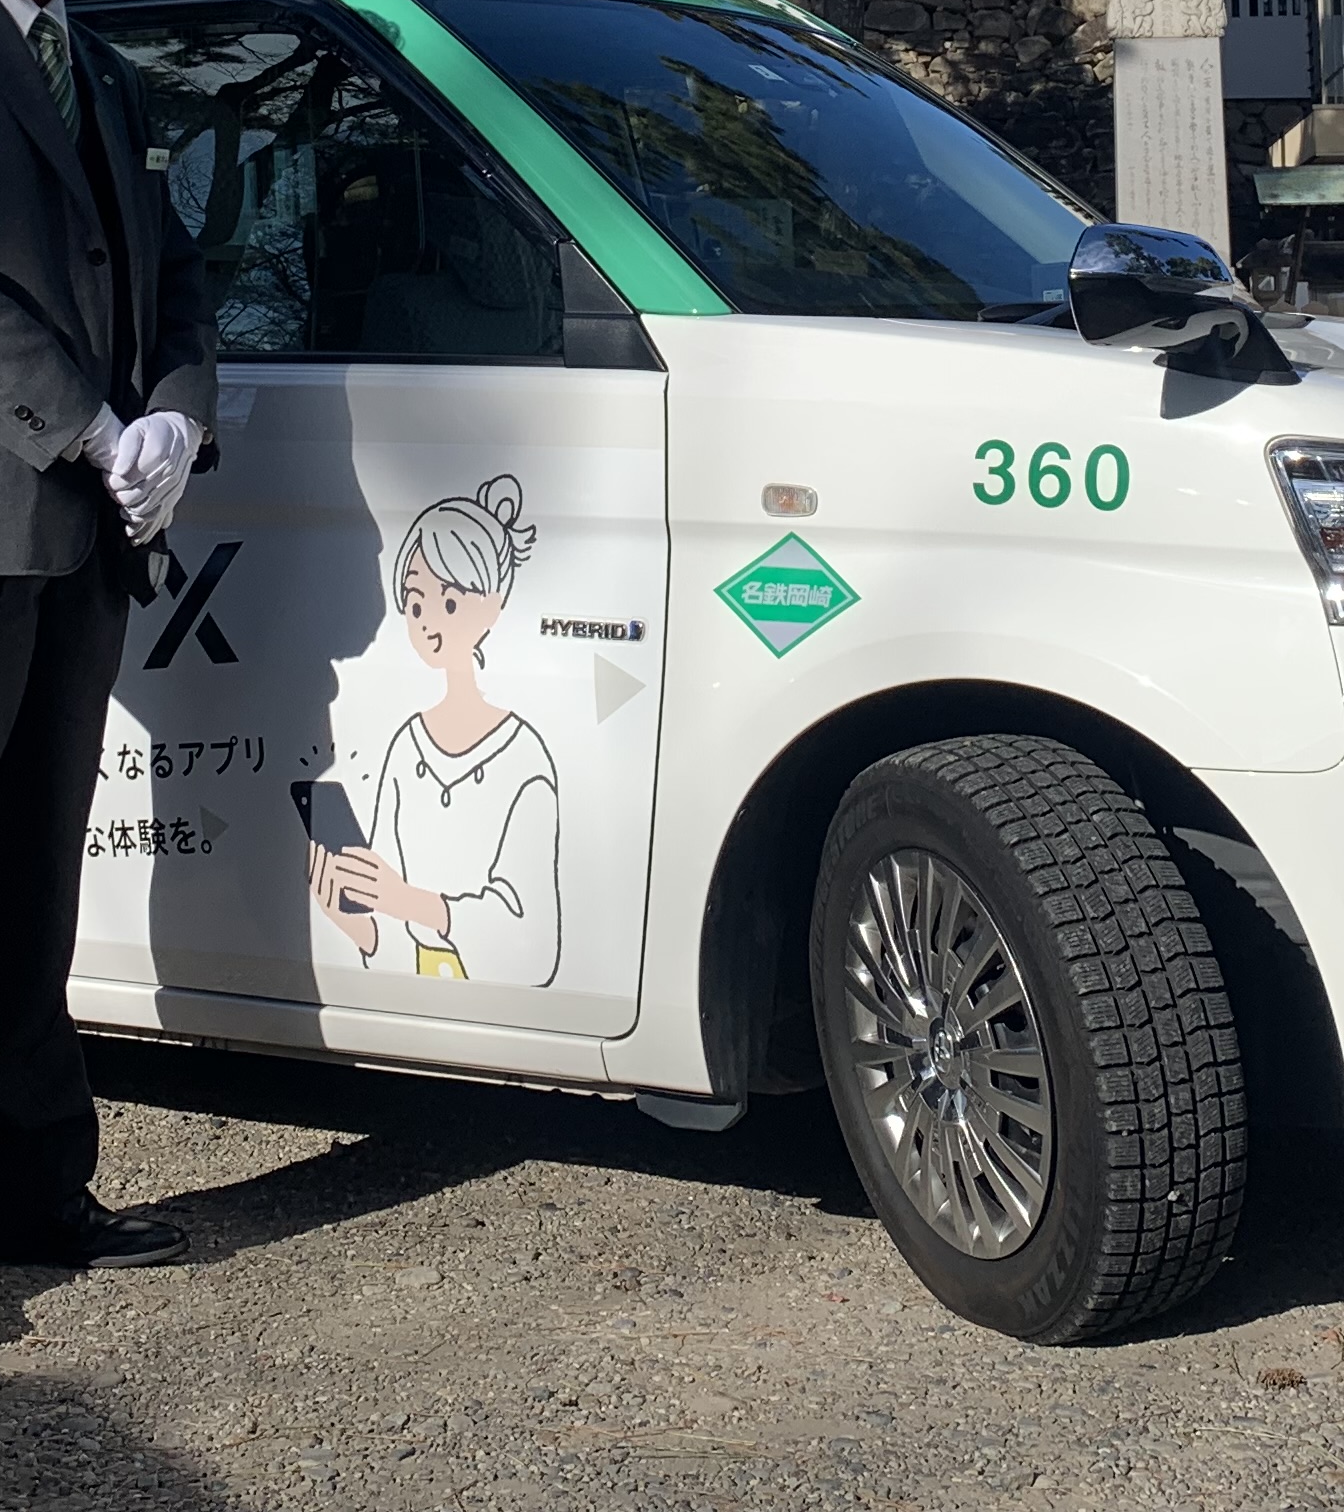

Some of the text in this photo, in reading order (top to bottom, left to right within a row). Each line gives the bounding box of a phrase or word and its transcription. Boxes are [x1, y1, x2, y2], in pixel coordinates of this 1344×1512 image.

[972, 439, 1131, 511] 360
[741, 581, 834, 608] 名鉄岡崎
[540, 618, 628, 640] HYBRID
[86, 817, 213, 858] な体験を。
